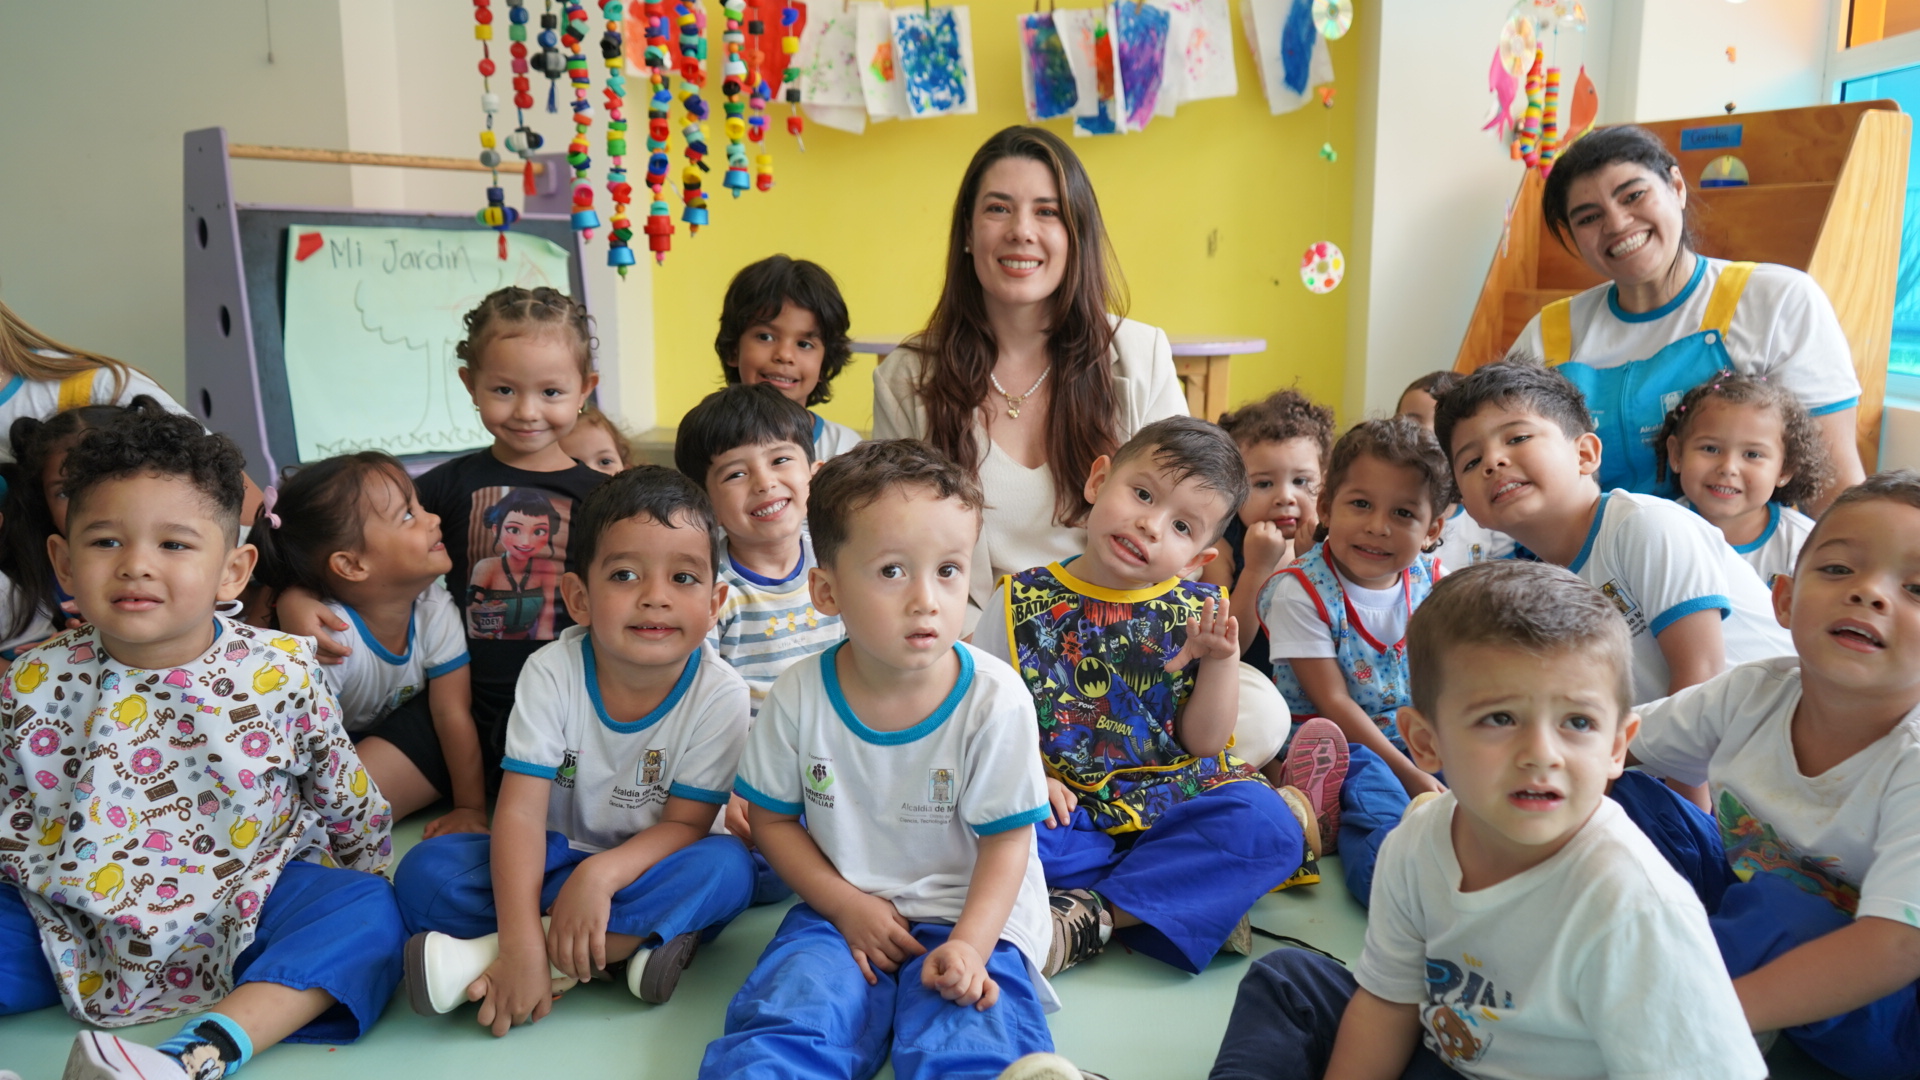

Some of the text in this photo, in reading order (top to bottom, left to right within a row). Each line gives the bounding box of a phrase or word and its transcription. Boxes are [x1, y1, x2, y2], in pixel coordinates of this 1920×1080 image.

[330, 237, 477, 283] Mi Jardin
[481, 617, 500, 626] ZOEY
[1016, 595, 1067, 622] BATMAN
[1084, 599, 1132, 627] BATMAN
[225, 721, 284, 745] CHOCOLATE
[1096, 715, 1133, 736] BATMAN
[113, 760, 179, 785] CHOCOLATE
[140, 797, 193, 827] Sweet
